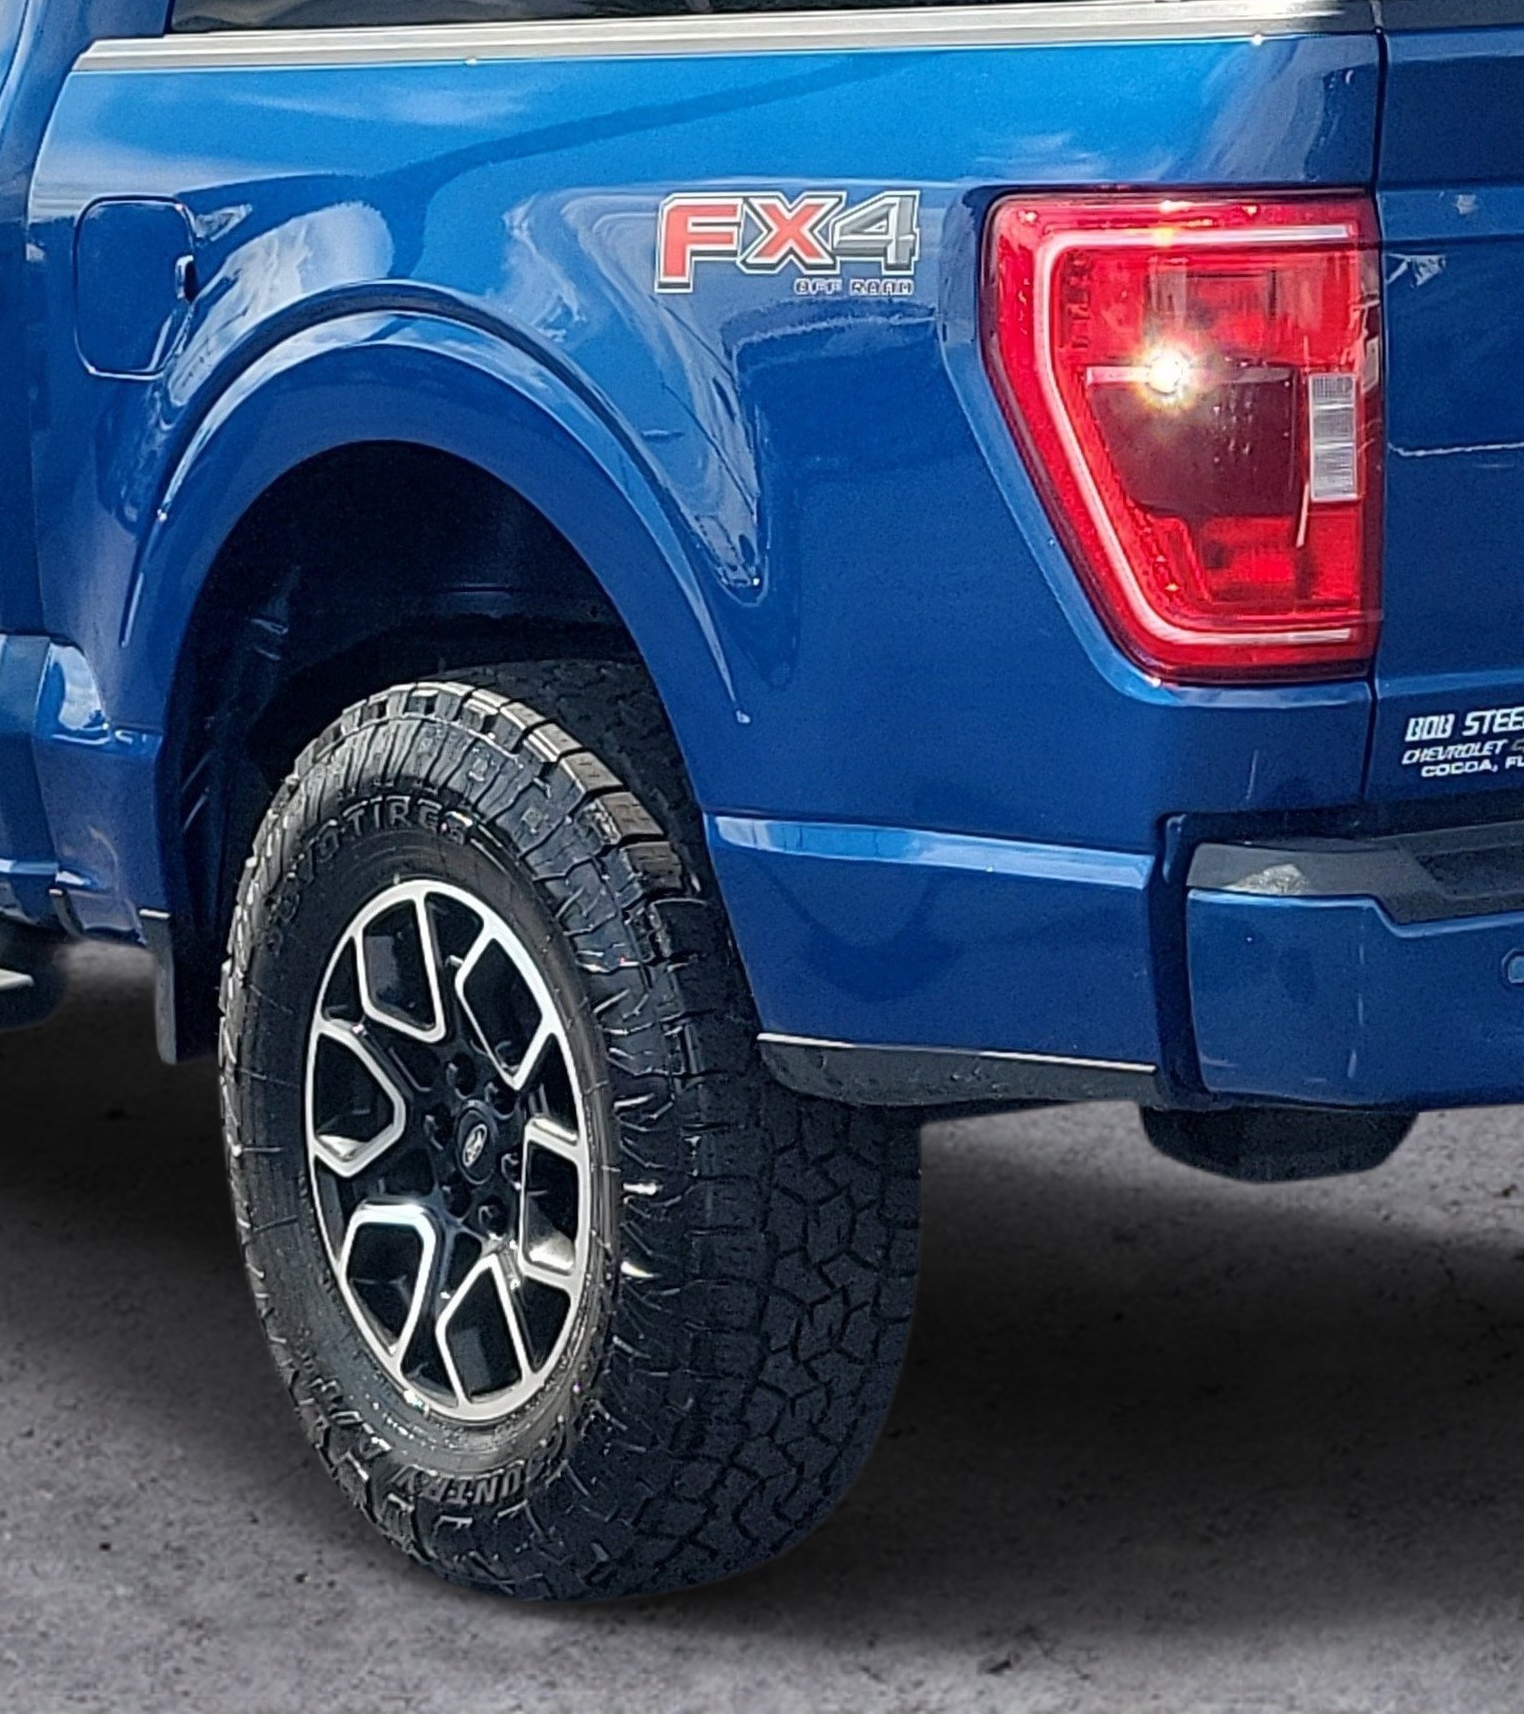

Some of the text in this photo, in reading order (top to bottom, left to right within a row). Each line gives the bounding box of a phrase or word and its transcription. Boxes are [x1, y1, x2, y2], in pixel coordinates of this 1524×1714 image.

[654, 190, 921, 294] FX4
[1404, 713, 1456, 743] BOB
[1400, 738, 1509, 765] CHEVROLET
[1420, 758, 1499, 778] COCOA,
[341, 794, 475, 846] TIRES
